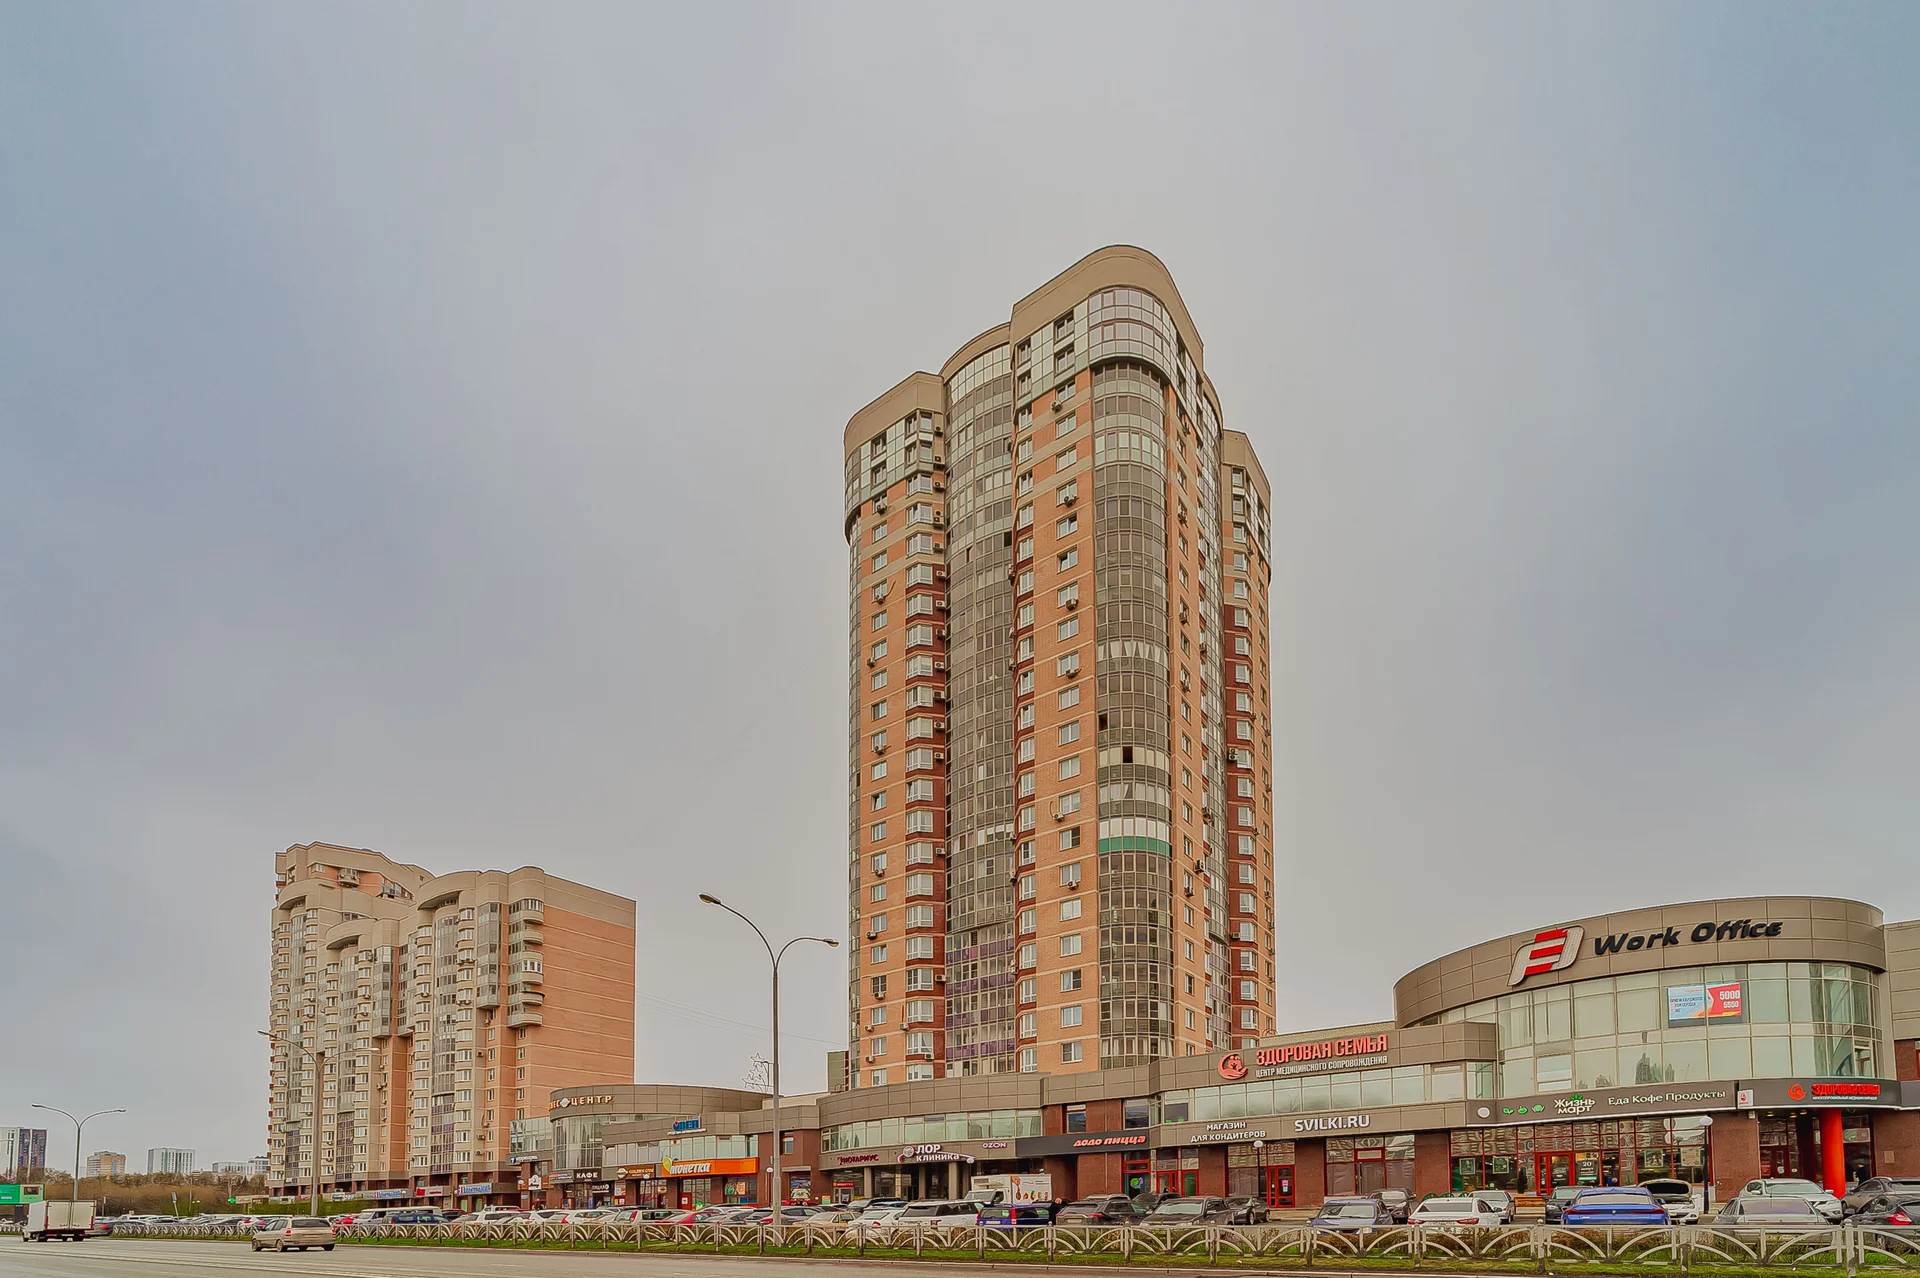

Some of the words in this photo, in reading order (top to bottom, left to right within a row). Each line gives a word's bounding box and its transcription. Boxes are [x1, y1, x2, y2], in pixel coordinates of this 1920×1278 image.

[1594, 926, 1681, 956] Work
[1690, 919, 1784, 943] Office
[1719, 990, 1740, 1000] 5000
[1255, 1041, 1332, 1066] ЗДОРОВАЯ
[1334, 1034, 1388, 1056] СЕМЬЯ
[1255, 1068, 1275, 1078] ЦЕНТР
[1275, 1062, 1327, 1075] МЕДИЦИНСКОГО
[1328, 1055, 1388, 1069] СОПРОВОЖДЕНИЯ
[1811, 1083, 1857, 1096] ЗДОРОВАЯ
[571, 1095, 612, 1106] ЦЕНТР
[1554, 1098, 1596, 1109] Жизнь
[1608, 1097, 1629, 1106] Еда
[1632, 1094, 1663, 1104] Кофе
[1665, 1090, 1726, 1102] Продукты
[1557, 1104, 1592, 1115] март
[1206, 1121, 1246, 1131] МАГАЗИН
[1294, 1114, 1370, 1132] SVILKI.RU
[1190, 1134, 1208, 1143] ДЛЯ
[1209, 1130, 1266, 1141] КОНДИТЕРОВ
[915, 1144, 941, 1154] ЛОР
[840, 1153, 880, 1164] НОТАРИУС
[916, 1153, 960, 1163] клиника
